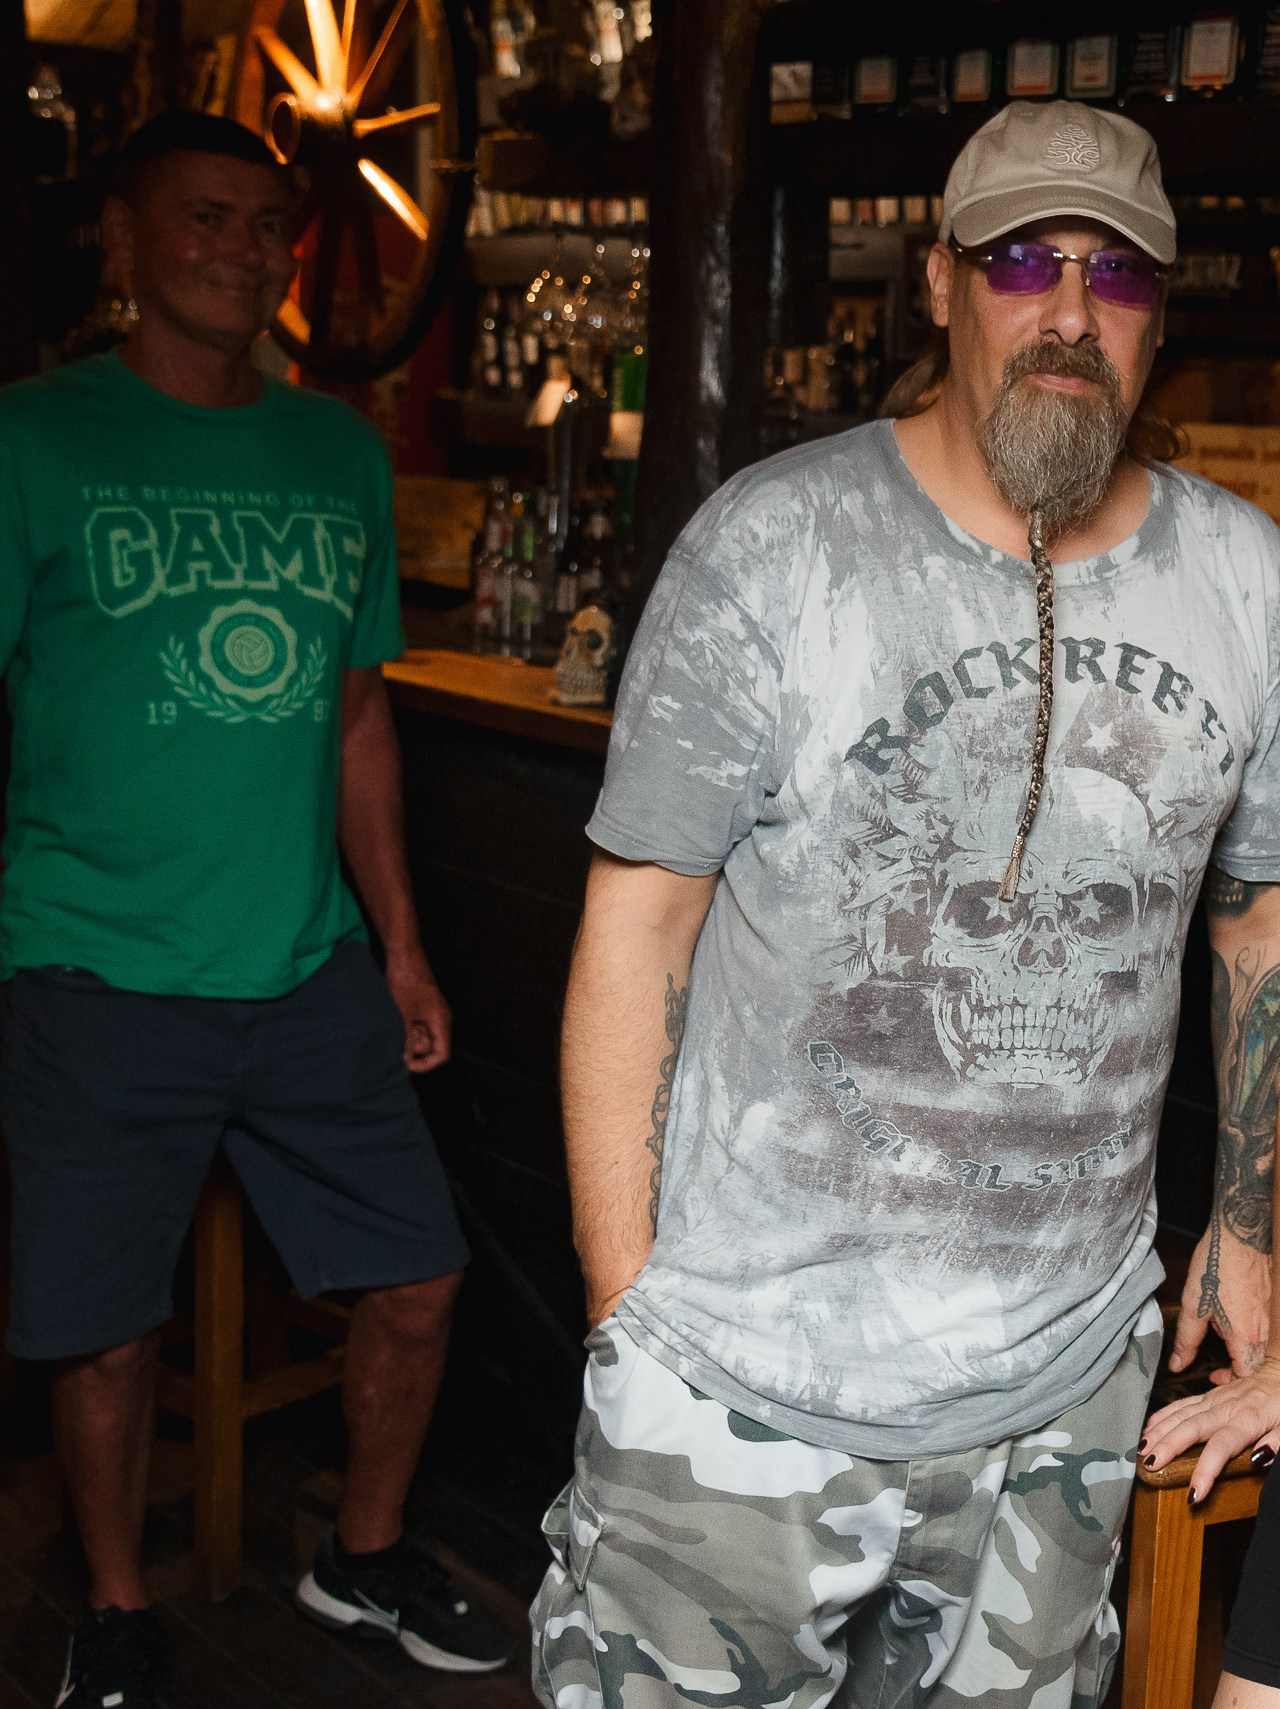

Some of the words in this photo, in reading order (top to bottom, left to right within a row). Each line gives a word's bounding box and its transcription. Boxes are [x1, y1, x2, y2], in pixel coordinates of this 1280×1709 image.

[82, 486, 131, 502] THE
[141, 487, 281, 508] BEGINNING
[290, 492, 316, 508] OF
[84, 505, 368, 619] GAME
[147, 701, 178, 725] 19
[844, 637, 1041, 776] ROCK
